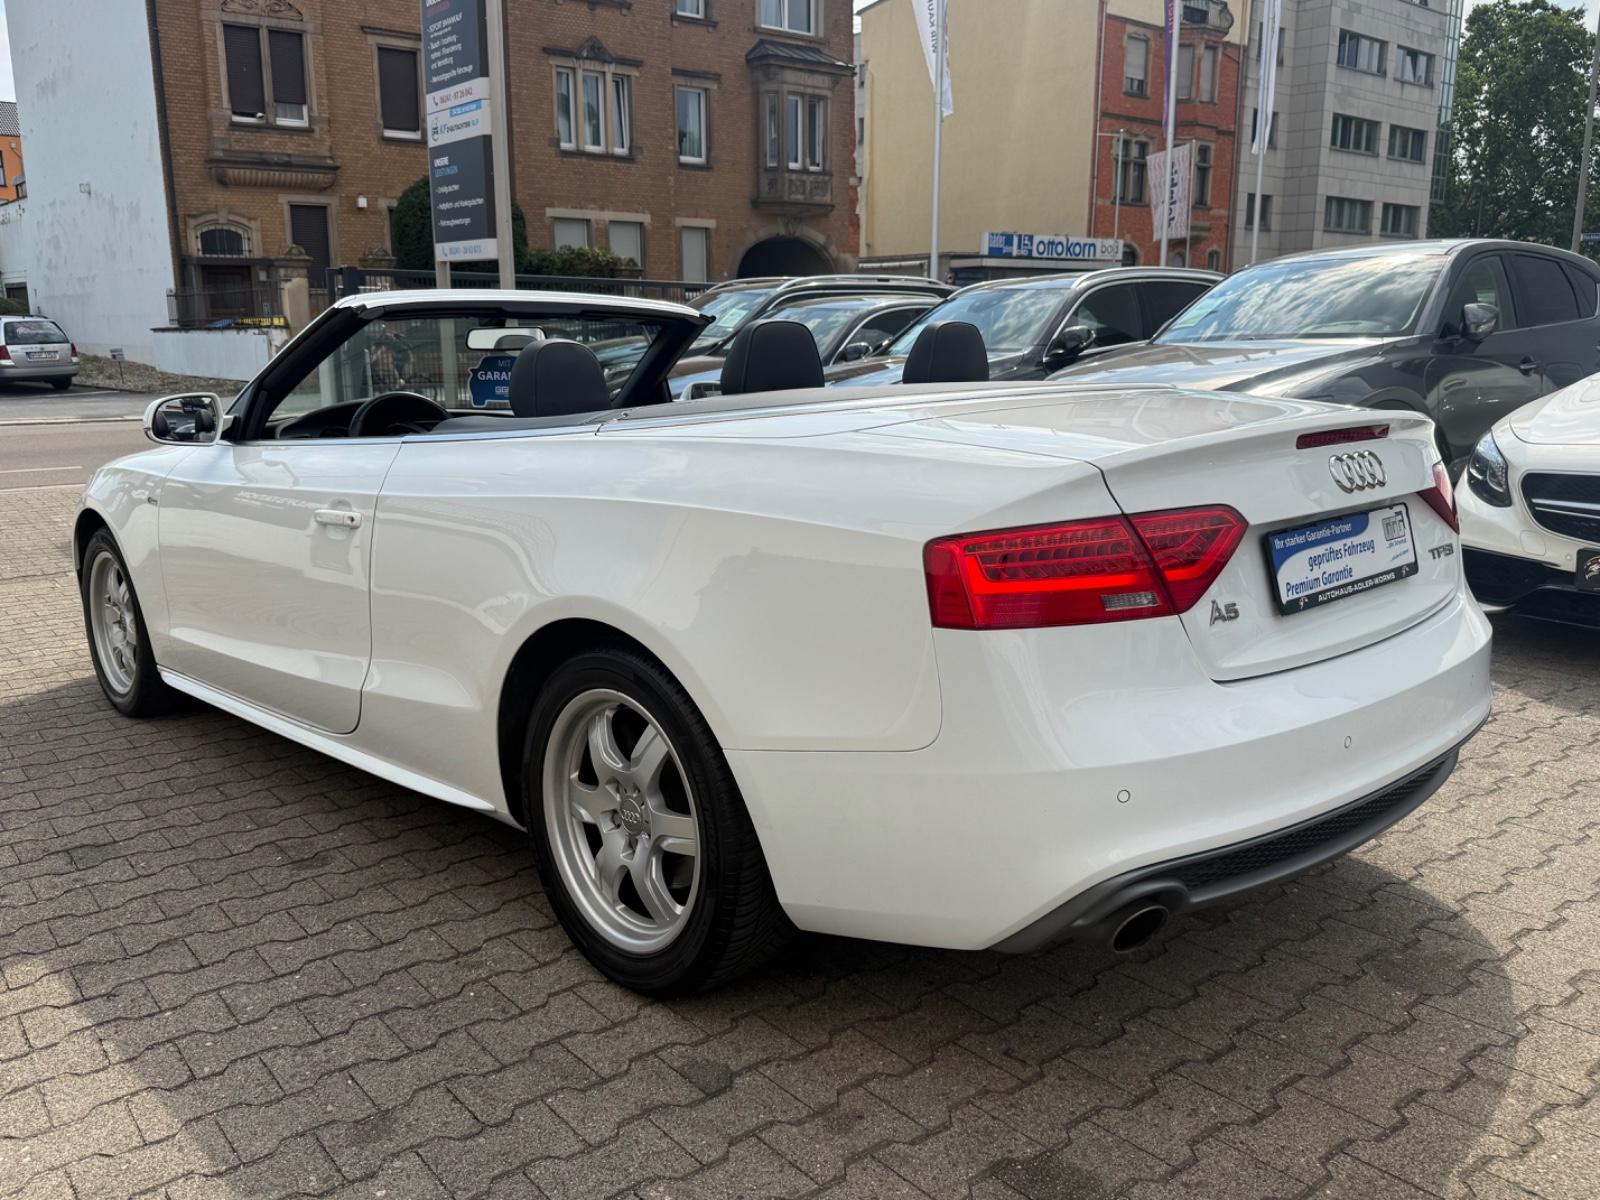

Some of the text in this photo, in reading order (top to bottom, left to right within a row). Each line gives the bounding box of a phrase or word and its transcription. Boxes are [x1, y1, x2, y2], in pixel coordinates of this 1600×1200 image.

[1036, 235, 1096, 257] ottokorn
[1274, 523, 1353, 549] Ihr starker Garantie-Partner
[1308, 546, 1343, 572] geprüftes
[1343, 539, 1376, 559] Fahrzeug
[1286, 565, 1353, 597] Premium Garantie
[1209, 600, 1240, 626] A5
